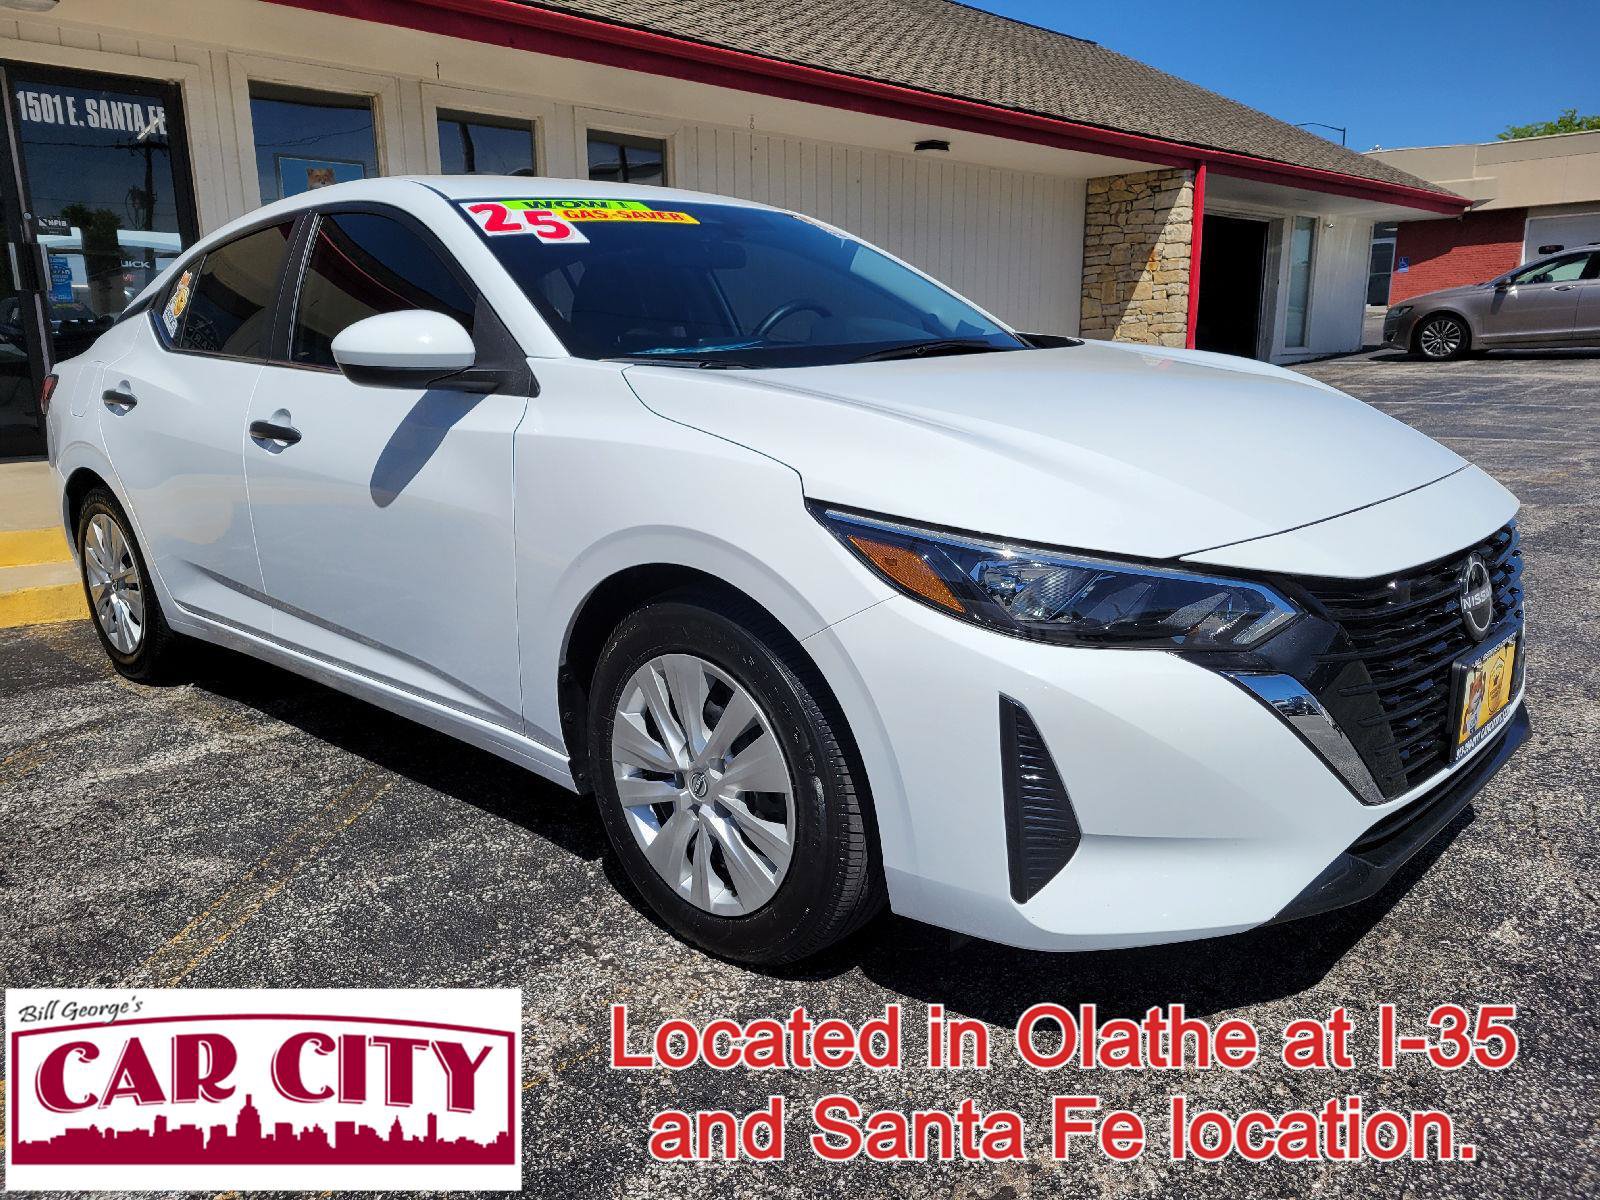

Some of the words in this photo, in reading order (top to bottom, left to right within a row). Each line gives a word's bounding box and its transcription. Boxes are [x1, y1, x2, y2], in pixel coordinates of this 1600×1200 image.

[16, 90, 64, 124] 1501
[66, 96, 85, 127] E.
[85, 98, 145, 131] SANTA
[148, 105, 168, 135] FE
[467, 203, 571, 240] 25
